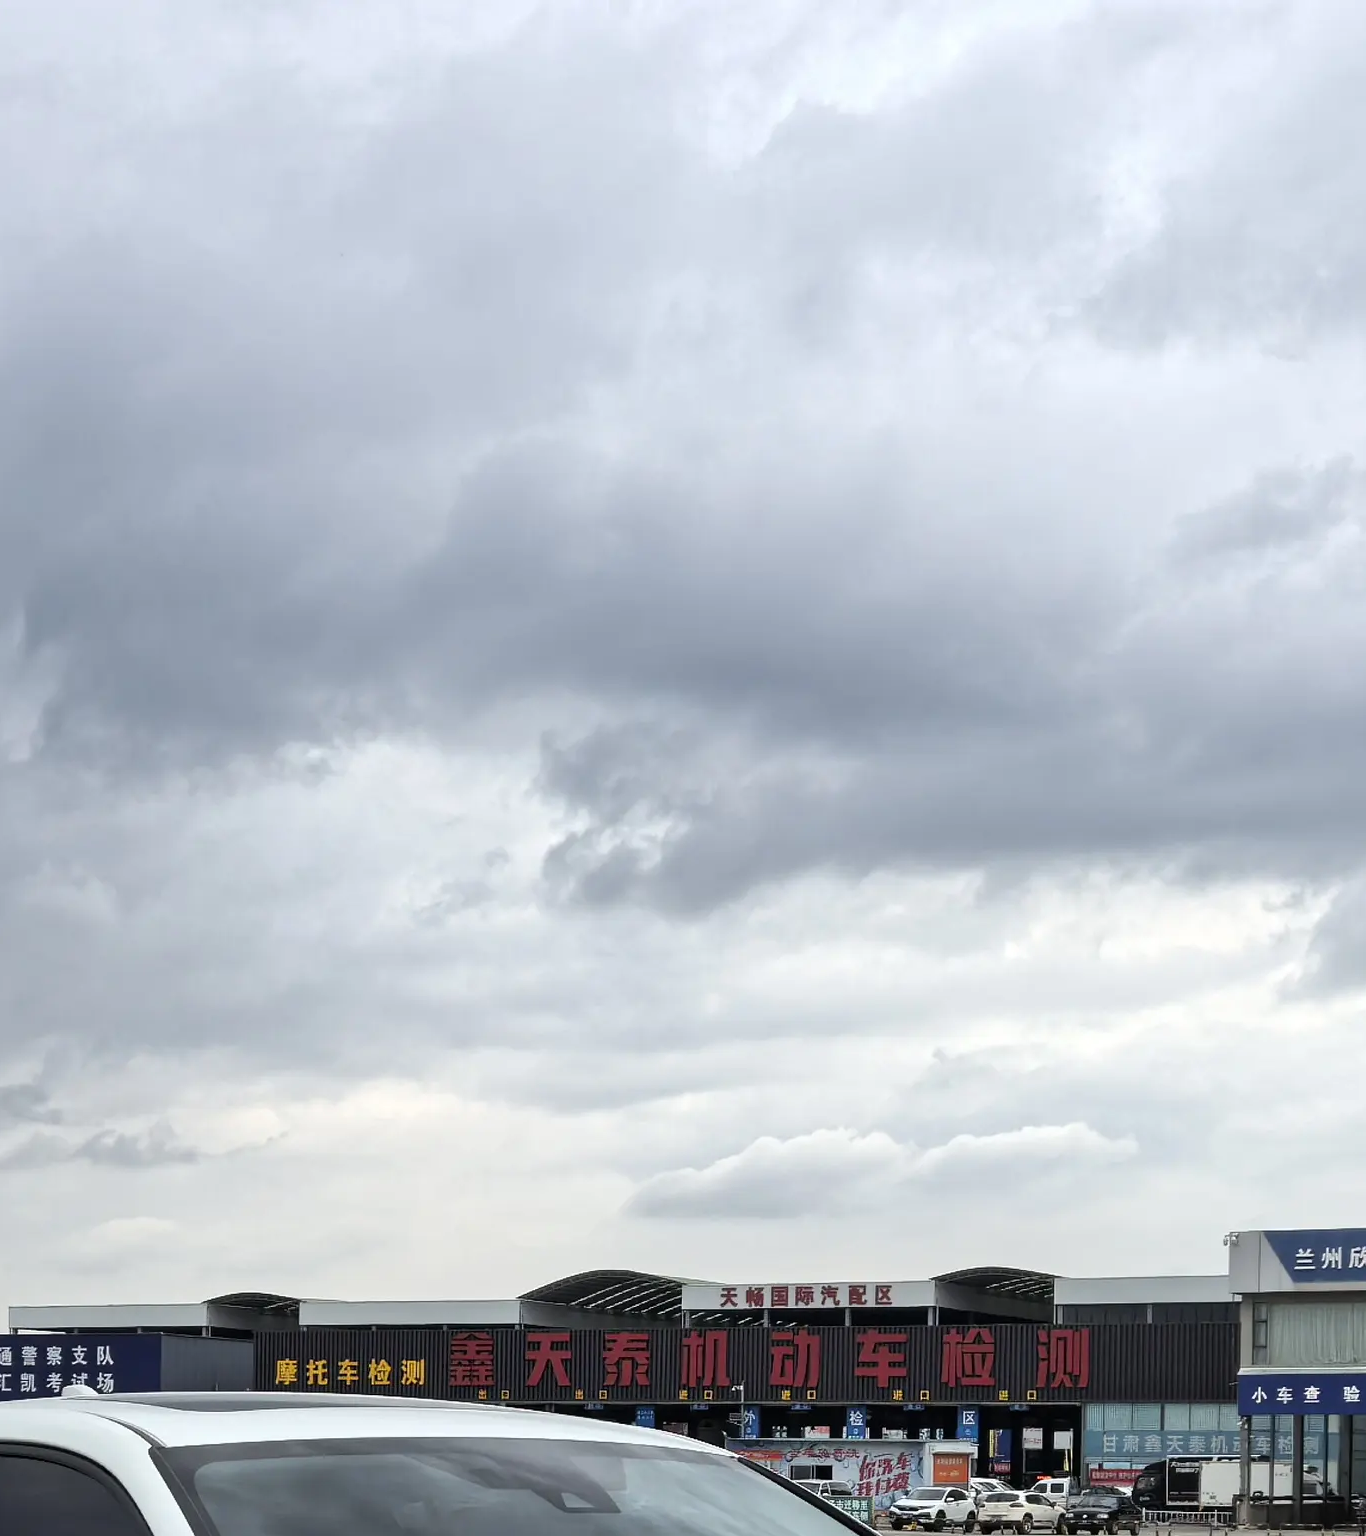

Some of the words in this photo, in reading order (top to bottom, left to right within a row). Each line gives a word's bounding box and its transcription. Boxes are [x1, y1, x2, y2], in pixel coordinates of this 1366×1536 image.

[720, 1284, 893, 1308] 天畅国际汽配区
[449, 1327, 1091, 1388] 鑫天泰机动车检测
[275, 1357, 425, 1386] 摩托车检测
[962, 1410, 976, 1425] 区
